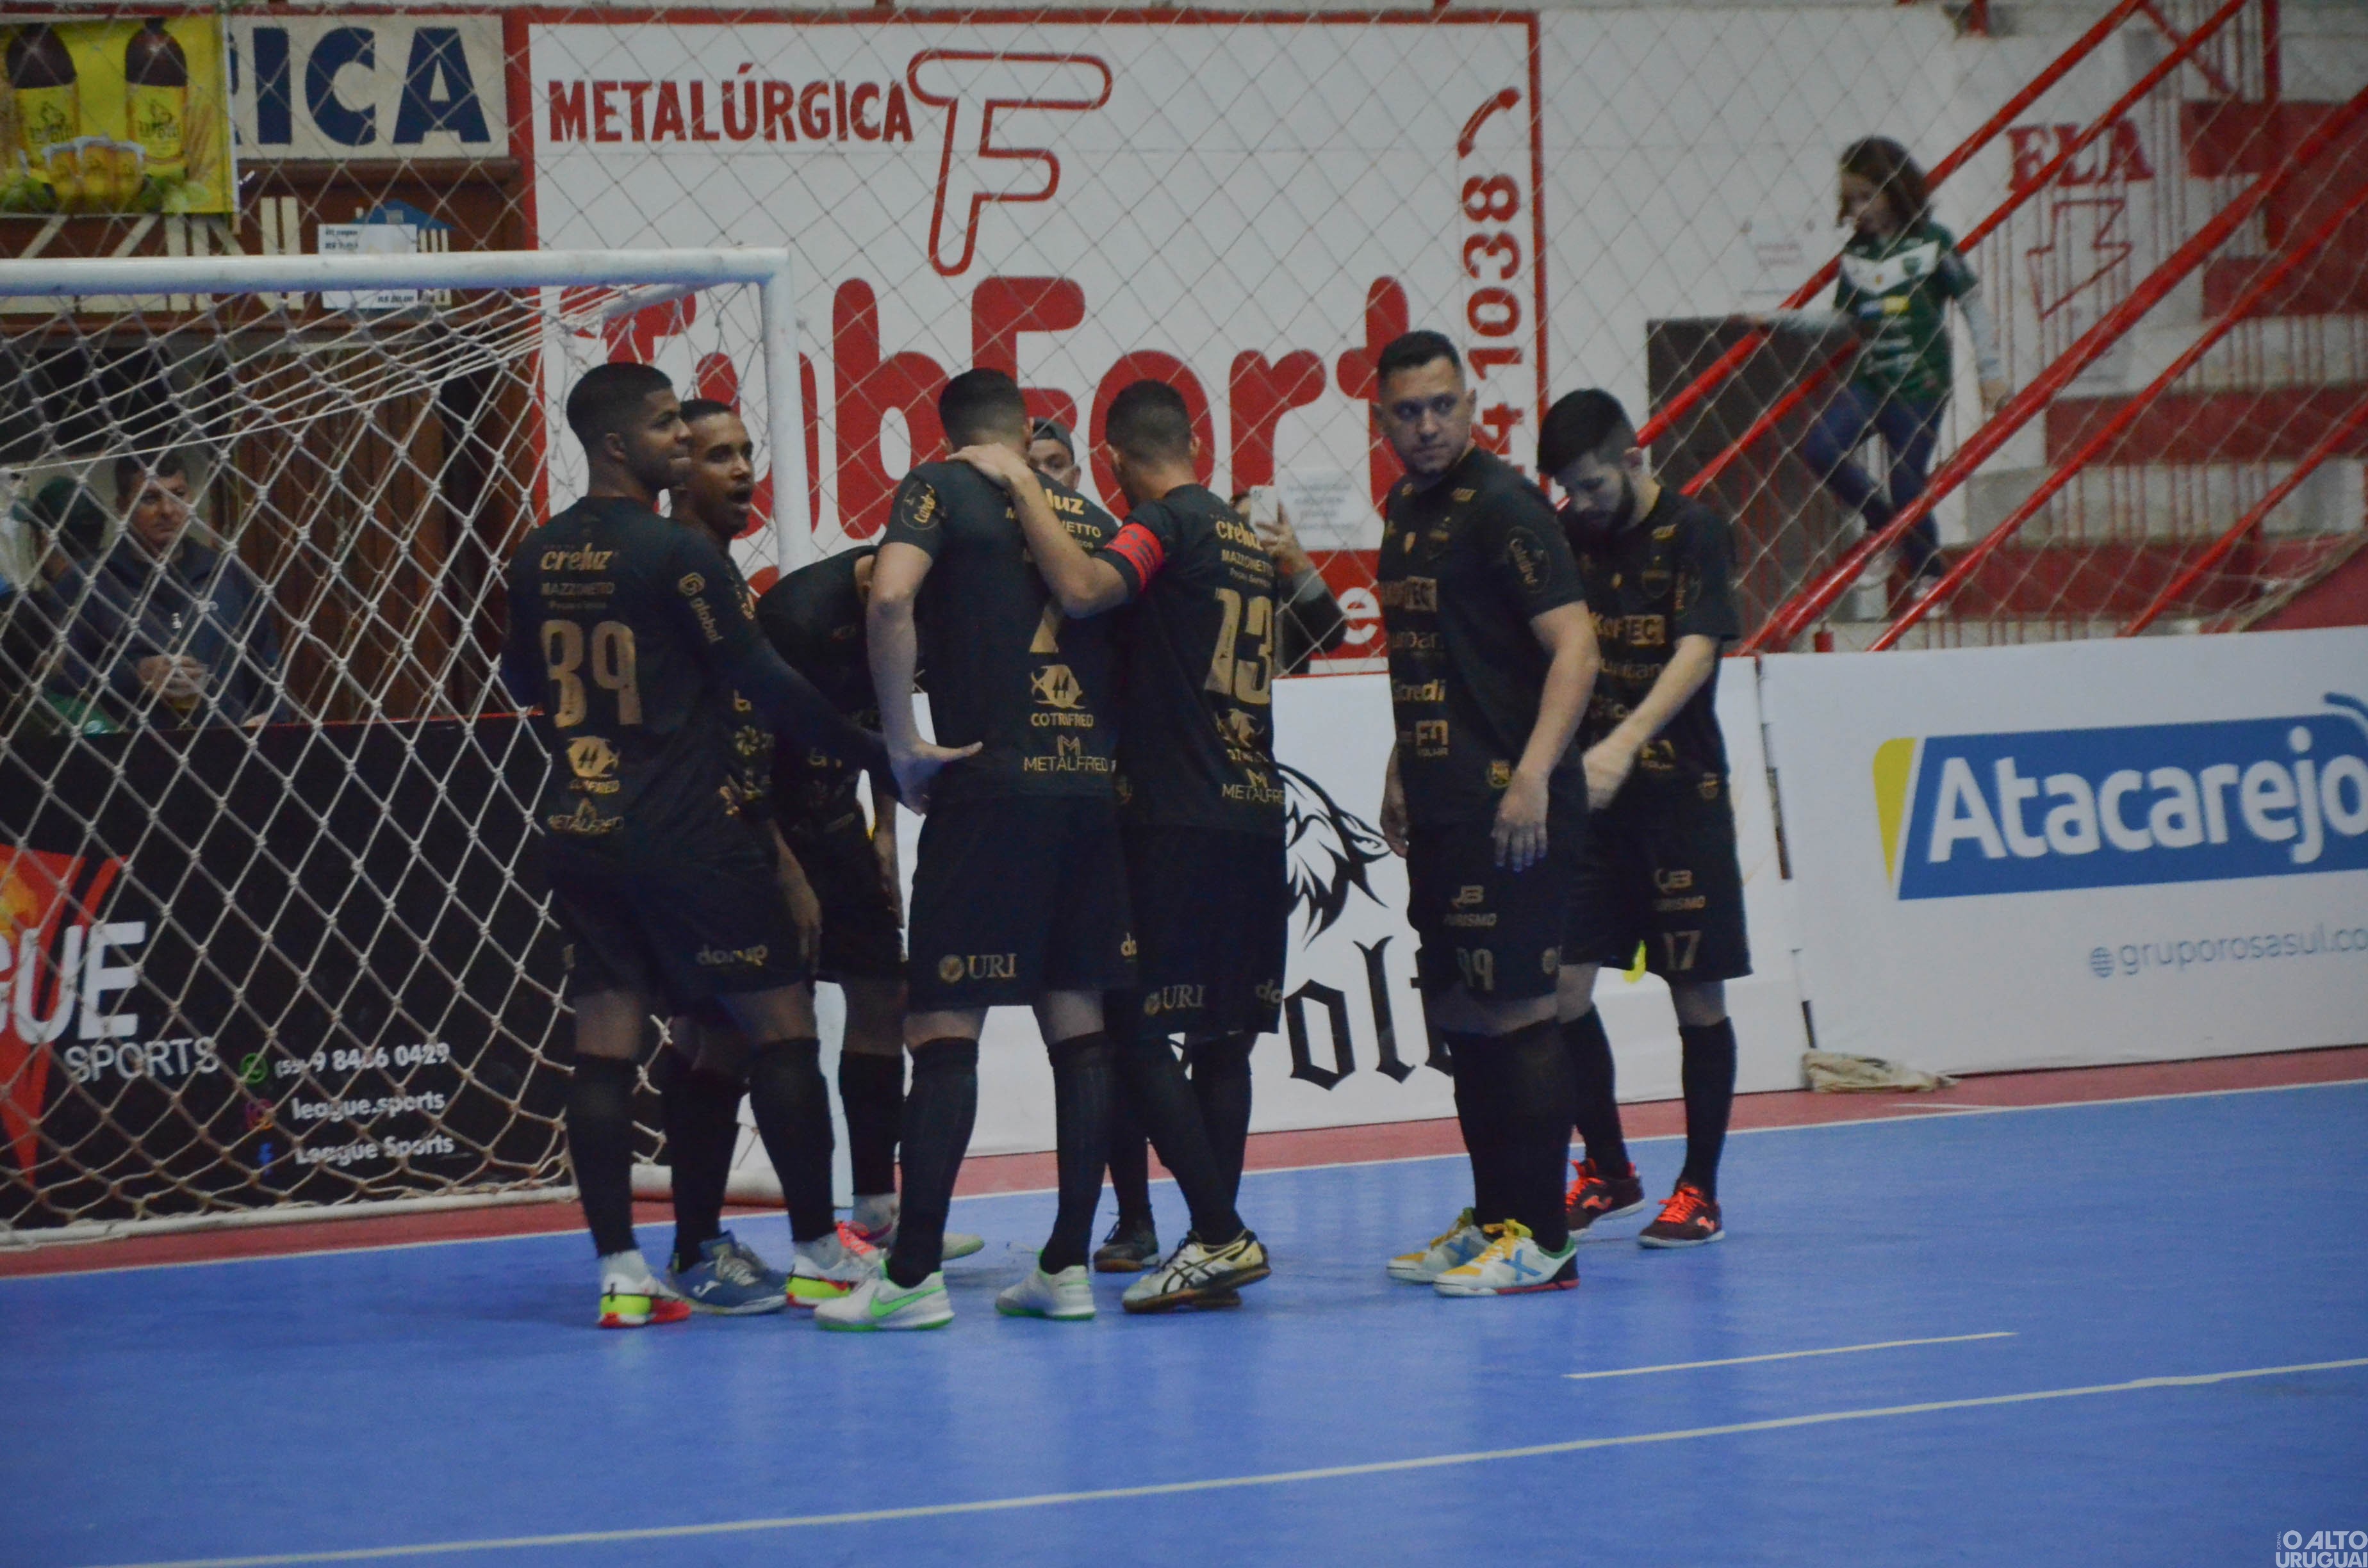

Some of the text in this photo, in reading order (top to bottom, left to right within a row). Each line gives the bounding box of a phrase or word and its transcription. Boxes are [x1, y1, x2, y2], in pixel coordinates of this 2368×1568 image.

[229, 27, 491, 145] ICA
[548, 63, 914, 143] METALÚRGICA
[1461, 174, 1524, 381] 1038
[1215, 520, 1264, 551] crelu
[540, 543, 614, 571] creluz
[691, 597, 724, 644] global
[540, 619, 643, 728] 89
[1030, 713, 1094, 728] COTRIFRED
[1023, 756, 1108, 772] METALFRED
[1929, 727, 2368, 864] Atacarejo
[967, 953, 1017, 979] URI
[1162, 984, 1207, 1010] URI
[65, 1036, 220, 1084] SPORTS
[312, 1050, 327, 1073] 9
[332, 1047, 390, 1072] 846
[394, 1042, 451, 1066] 0429
[295, 1146, 378, 1167] League
